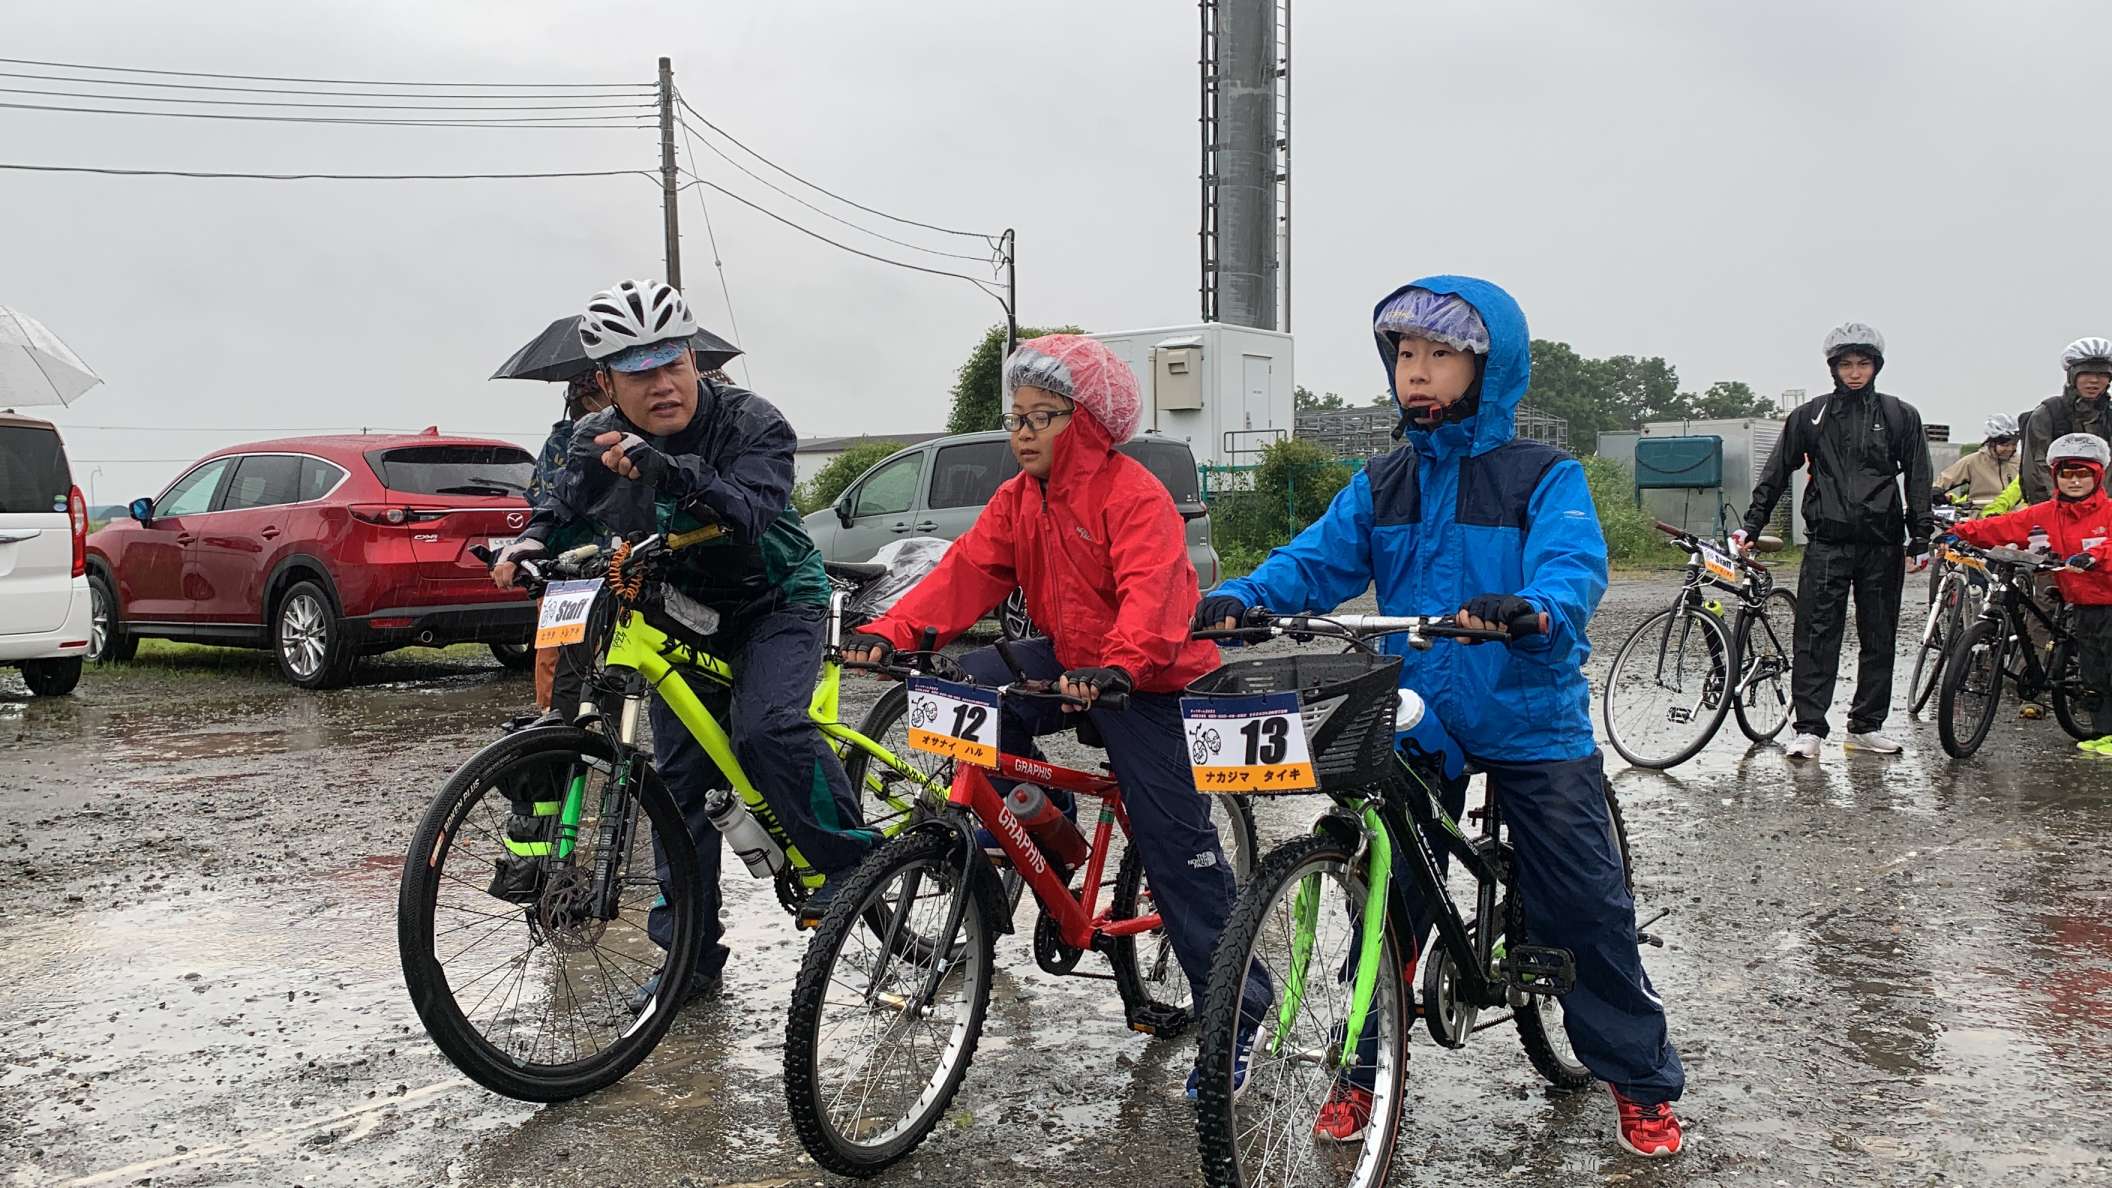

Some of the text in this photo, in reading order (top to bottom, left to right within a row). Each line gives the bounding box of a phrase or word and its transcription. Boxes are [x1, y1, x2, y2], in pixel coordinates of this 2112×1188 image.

[556, 598, 590, 622] Staff
[950, 703, 988, 742] 12
[922, 734, 984, 757] オサナイ ハル
[1240, 716, 1289, 766] 13
[1015, 758, 1053, 780] GRAPHIS
[1205, 768, 1301, 783] ナカジマ タイキ
[462, 778, 481, 800] PLUS
[997, 806, 1047, 874] GRAPHIS
